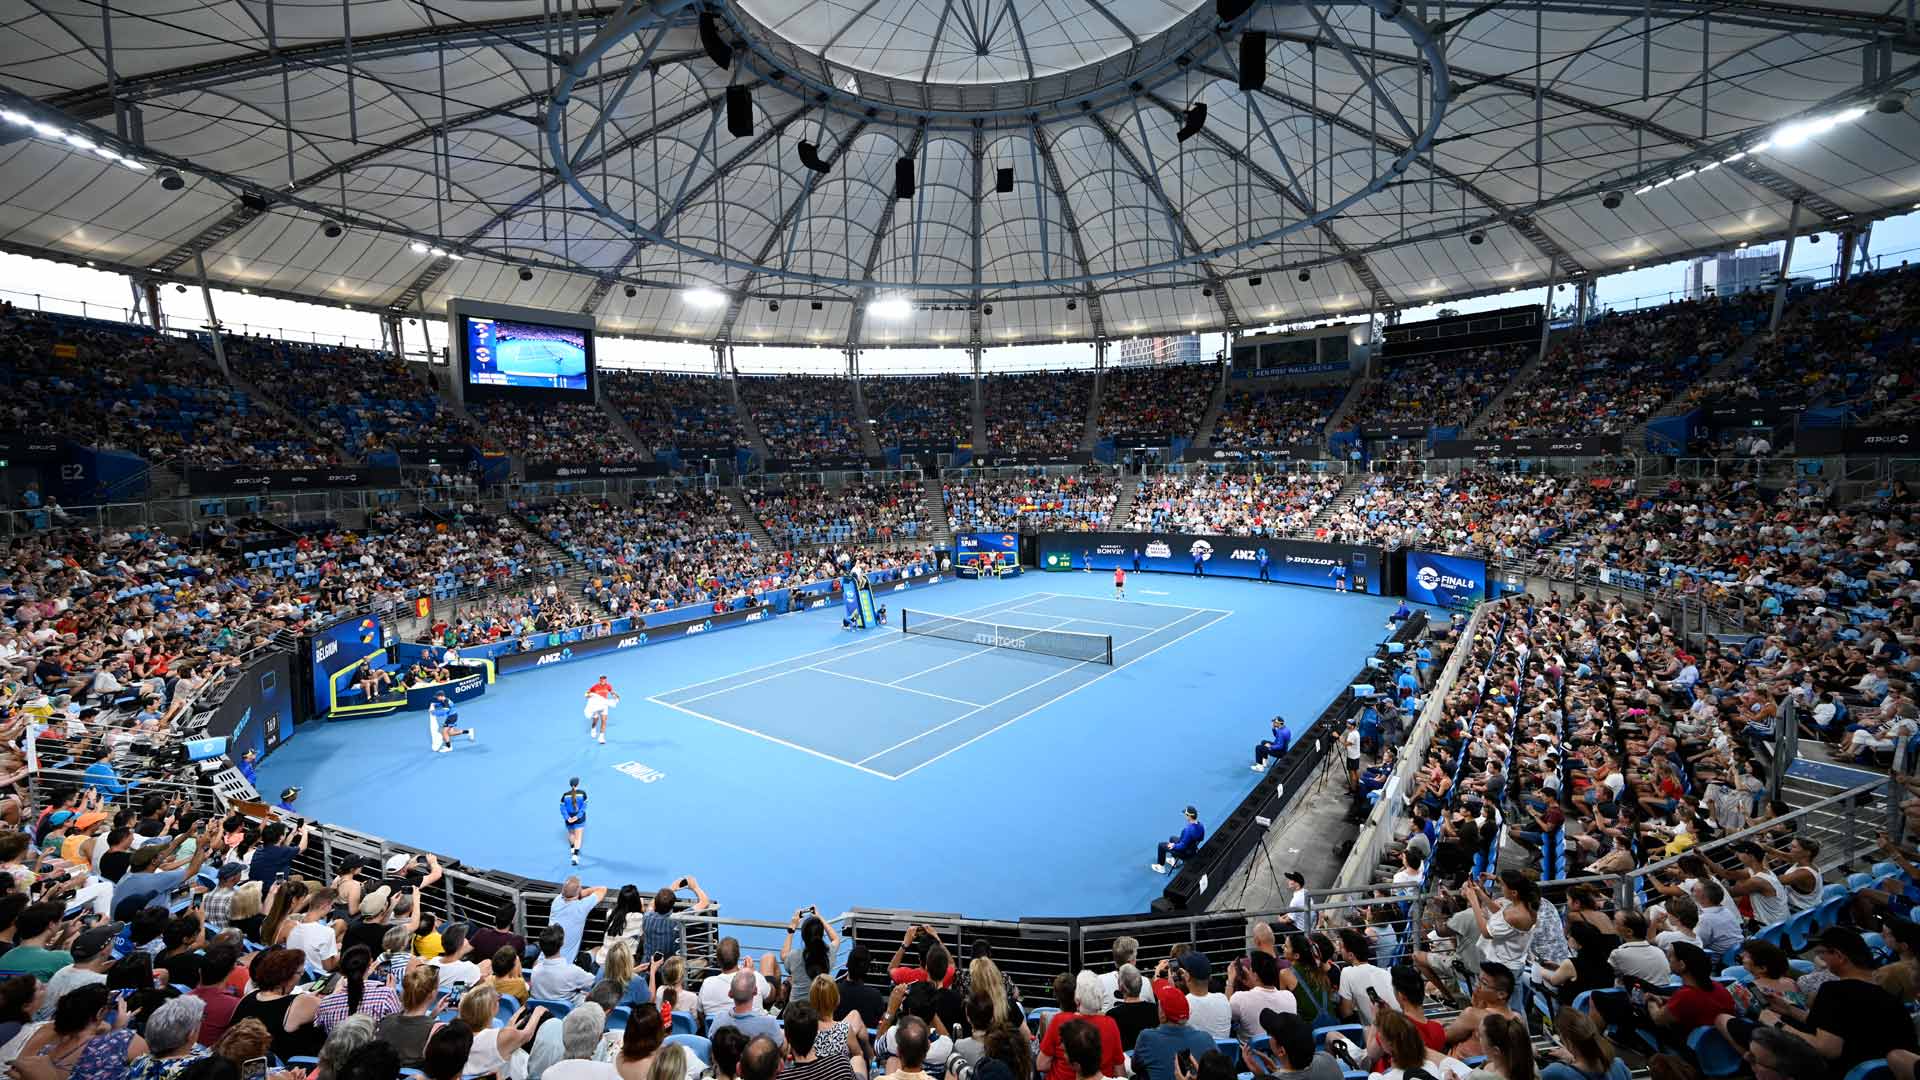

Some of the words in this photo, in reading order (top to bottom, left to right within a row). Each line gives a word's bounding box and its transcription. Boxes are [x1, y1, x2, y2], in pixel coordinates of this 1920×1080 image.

[60, 463, 86, 481] E2
[569, 467, 588, 475] NSW
[1229, 549, 1256, 561] ANZ
[1293, 556, 1336, 566] DUNLOP
[1441, 575, 1467, 588] FINAL
[1467, 579, 1475, 589] 8
[745, 611, 762, 623] ANZ
[686, 623, 704, 635] ANZ
[616, 636, 639, 649] ANZ
[315, 639, 339, 664] BELGIUM
[536, 652, 561, 666] ANZ
